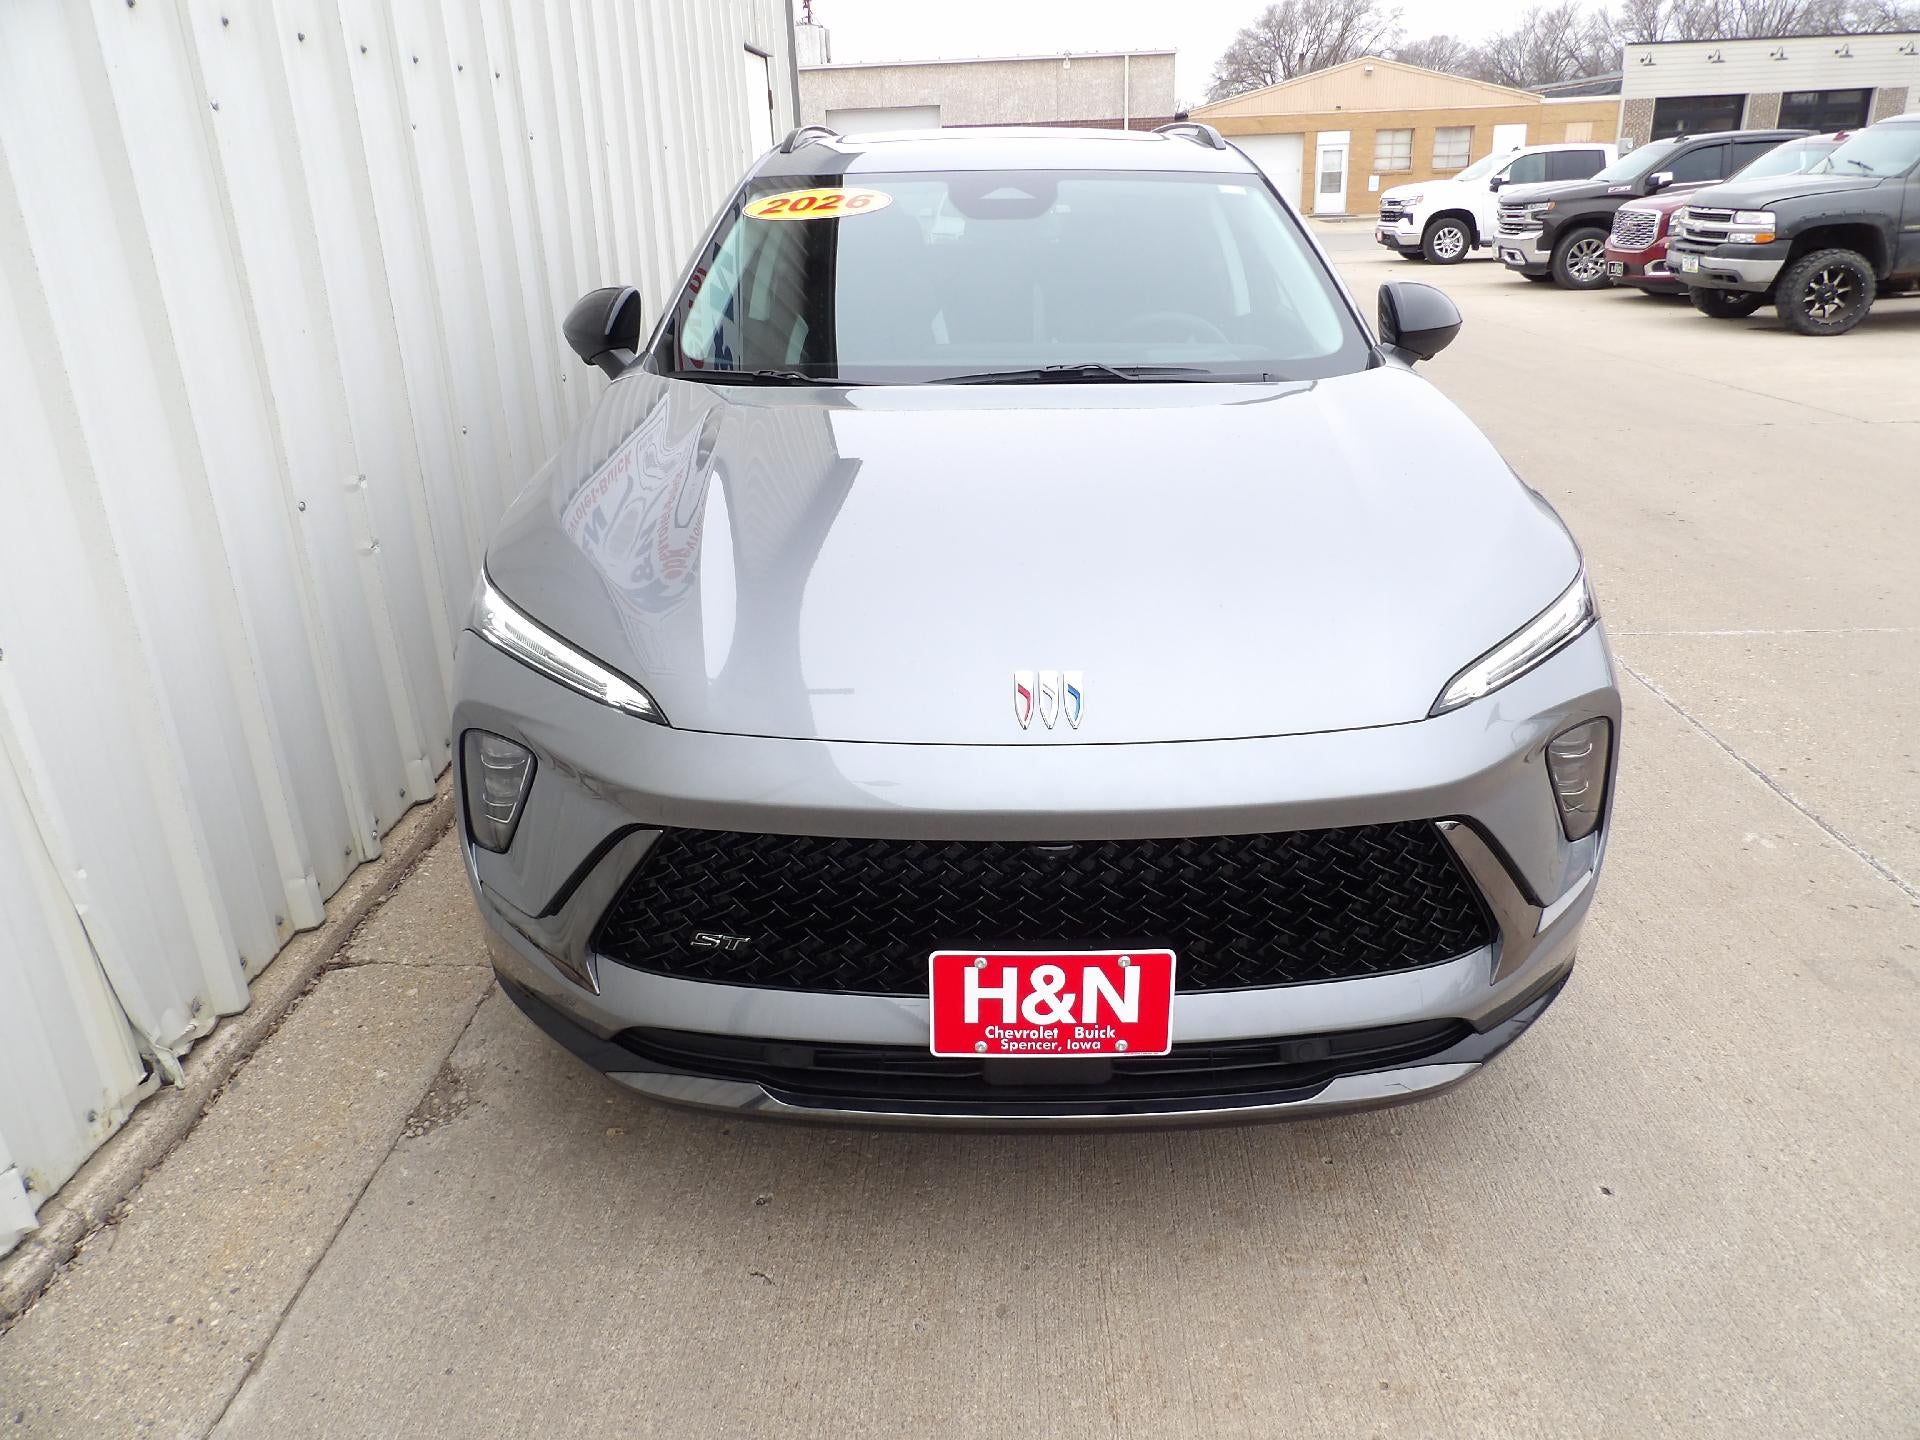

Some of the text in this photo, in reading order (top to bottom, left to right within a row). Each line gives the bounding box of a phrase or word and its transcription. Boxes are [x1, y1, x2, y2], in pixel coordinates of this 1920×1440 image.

[758, 194, 874, 215] 2026
[690, 932, 751, 951] ST
[963, 964, 1141, 1025] H&N
[984, 1024, 1116, 1039] Chevrolet Buick
[1000, 1038, 1101, 1052] Spencer, Iowa
